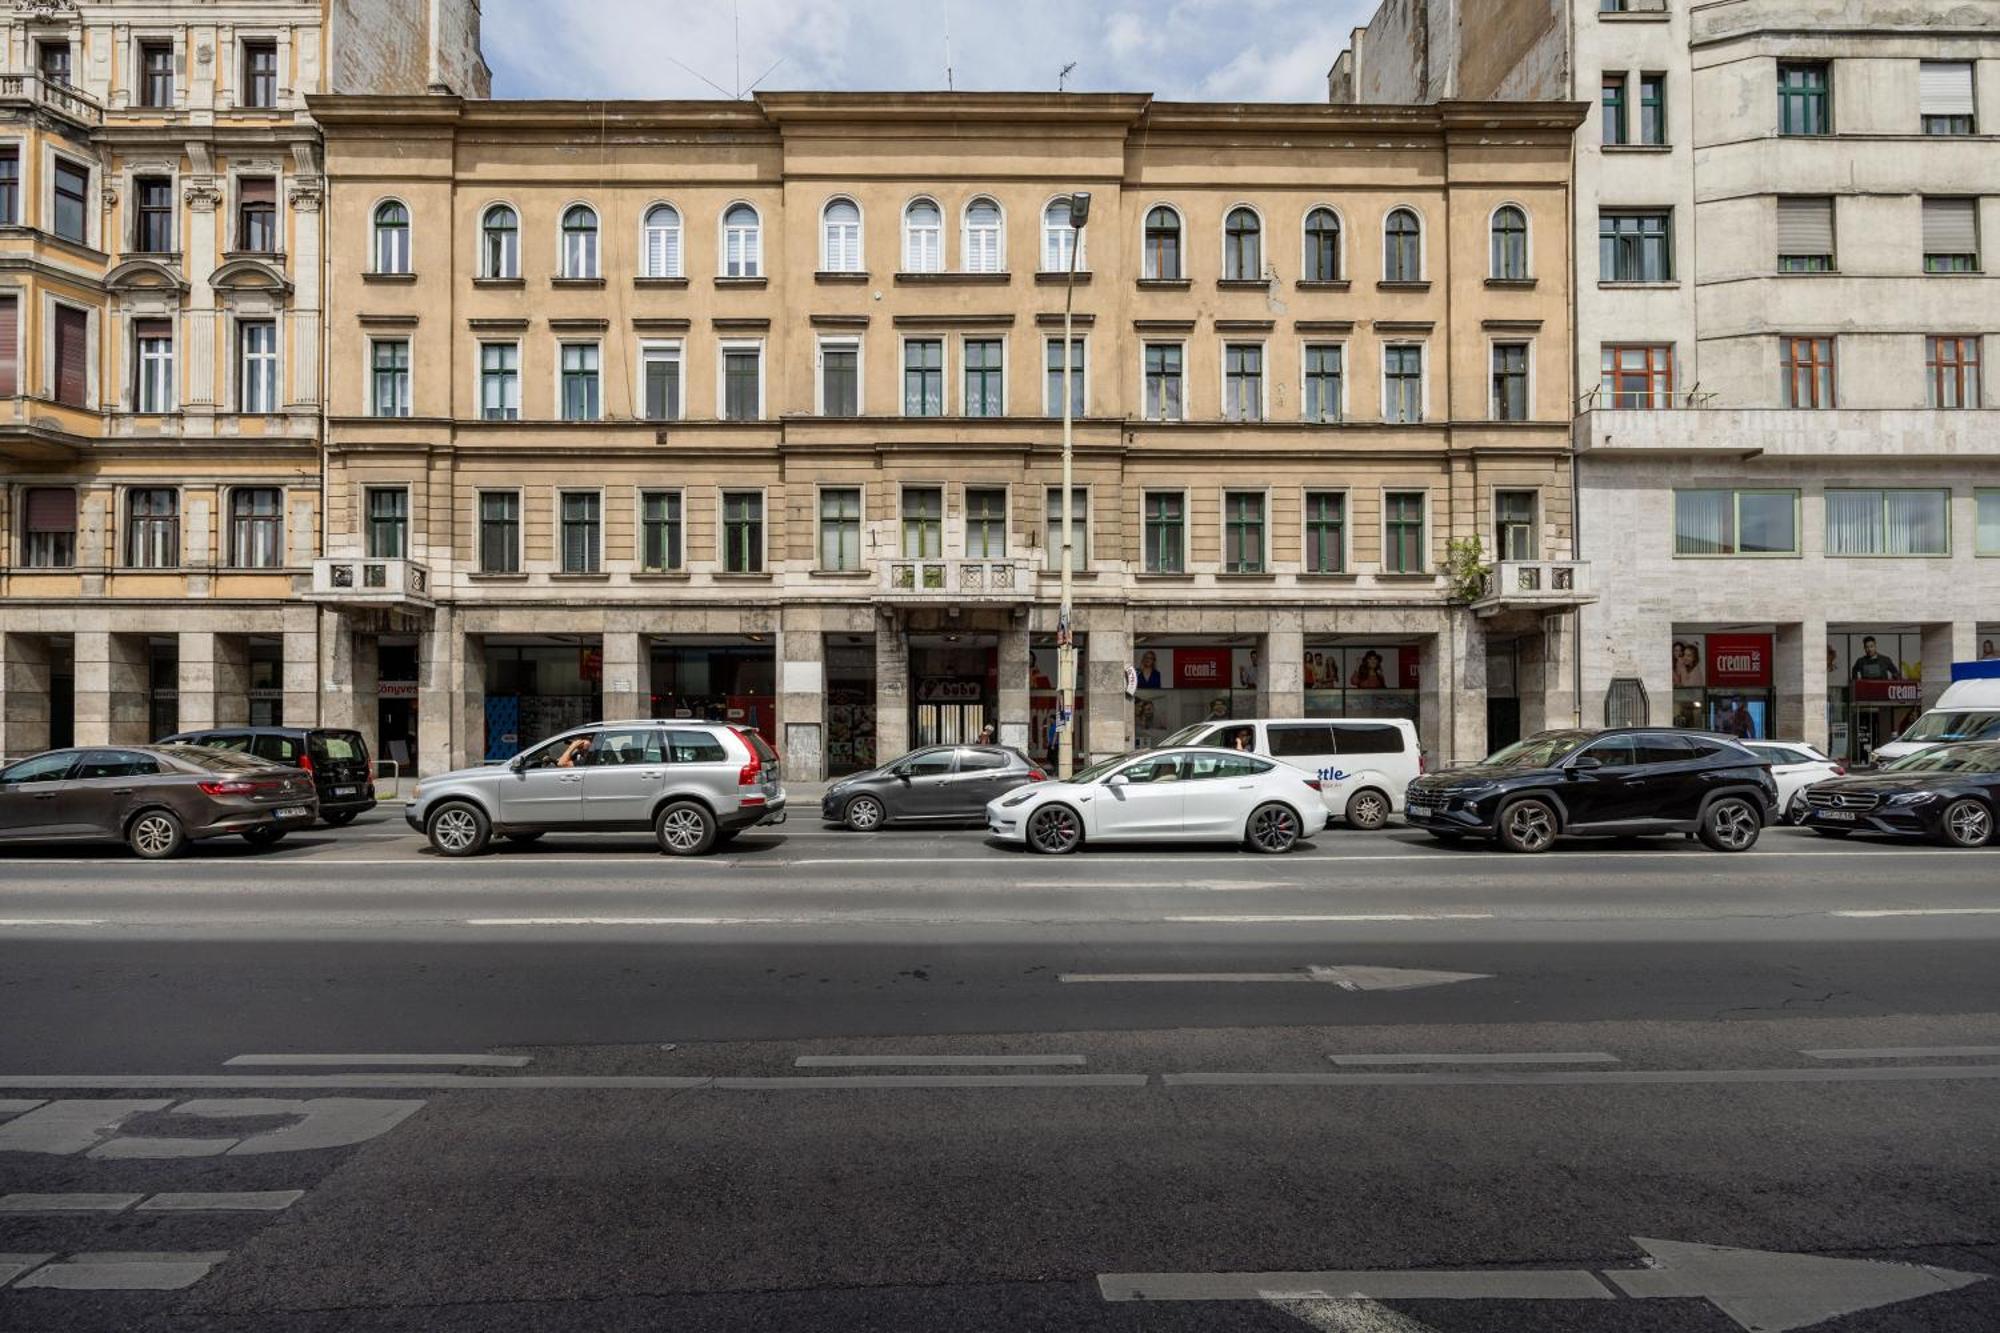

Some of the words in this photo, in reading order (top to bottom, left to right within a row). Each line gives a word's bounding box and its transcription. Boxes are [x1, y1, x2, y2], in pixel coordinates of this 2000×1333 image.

[1184, 663, 1210, 677] cream
[1717, 655, 1751, 672] cream
[1888, 685, 1917, 700] cream
